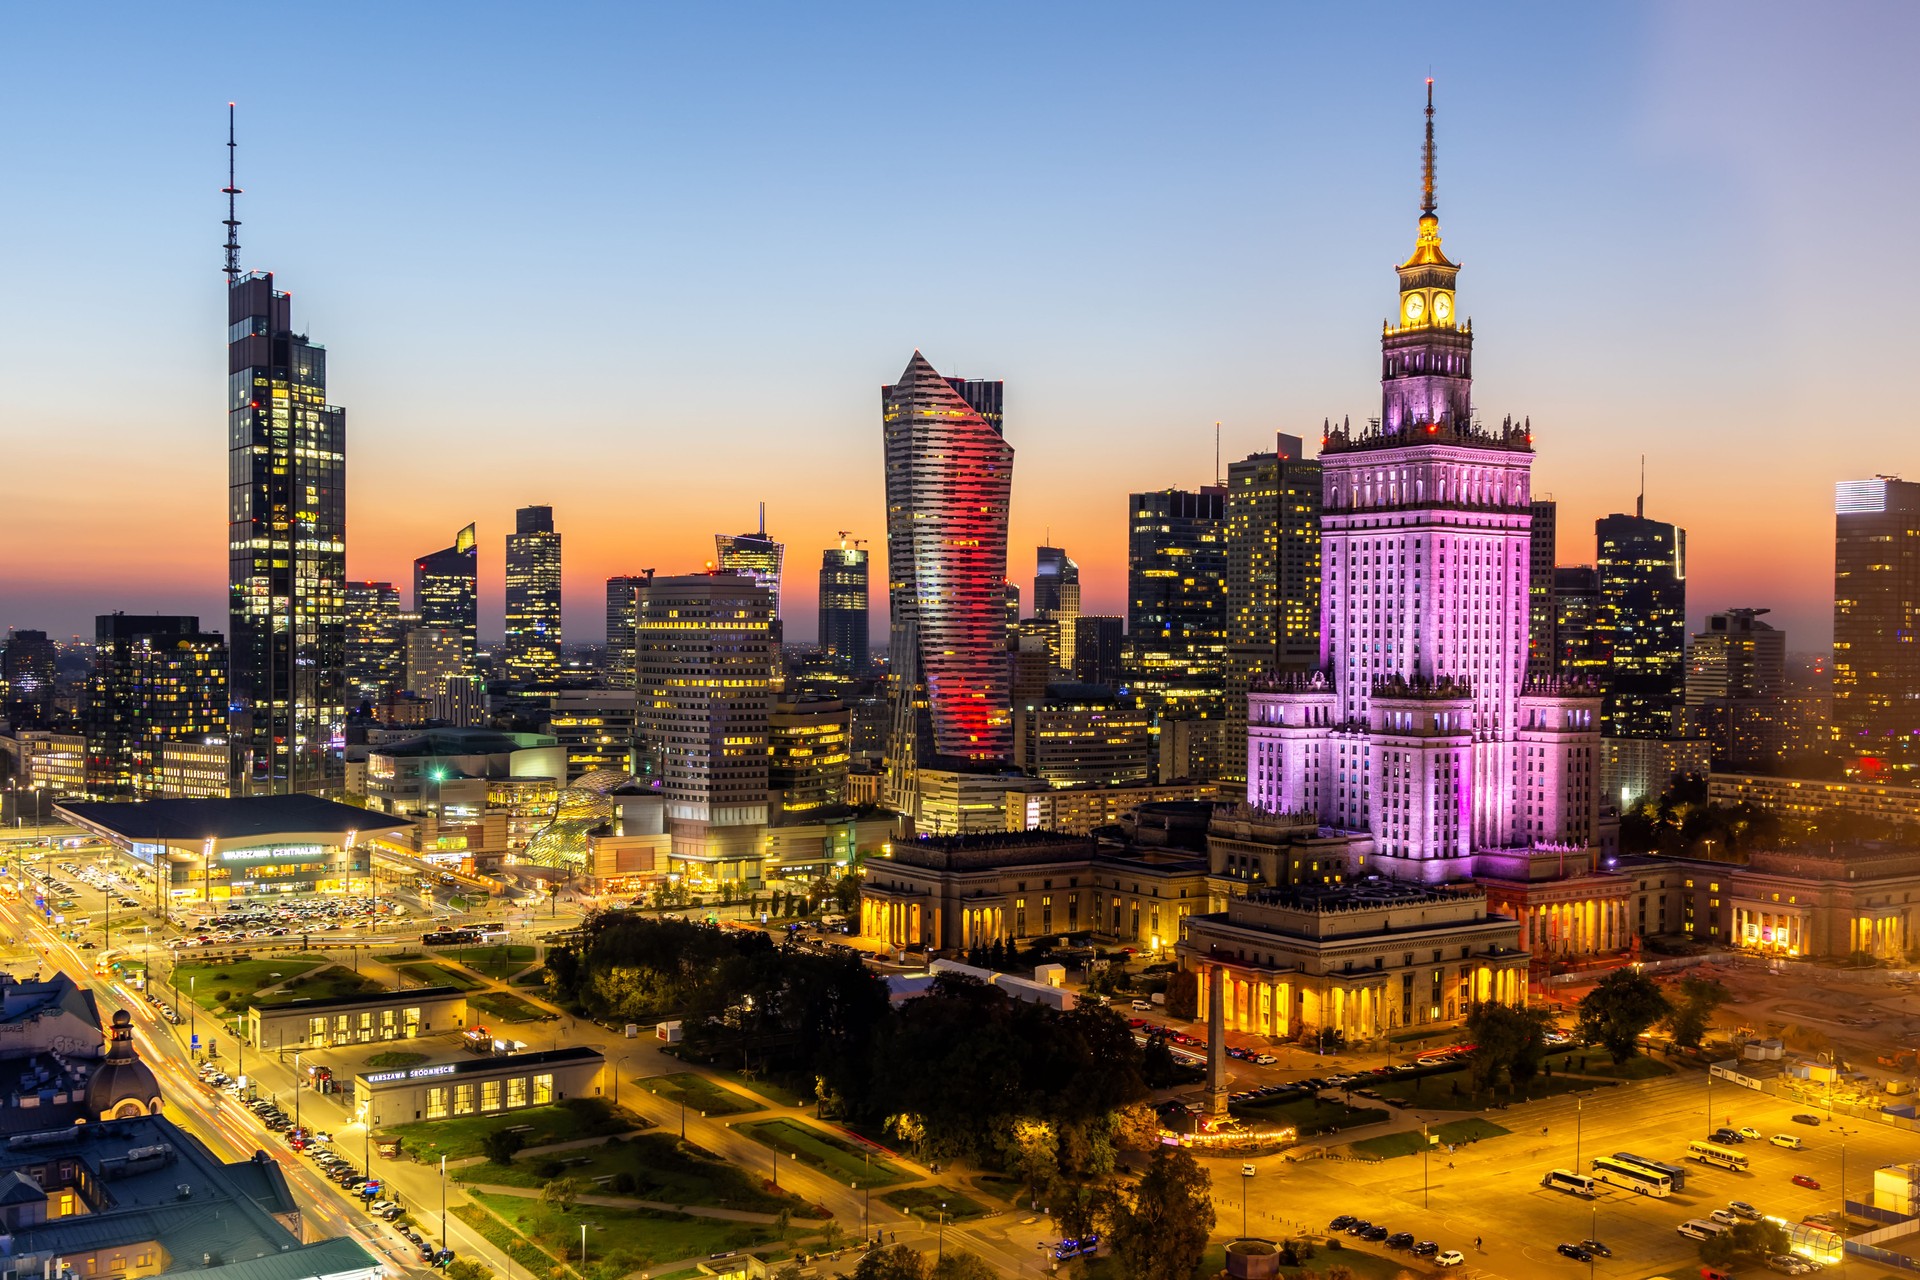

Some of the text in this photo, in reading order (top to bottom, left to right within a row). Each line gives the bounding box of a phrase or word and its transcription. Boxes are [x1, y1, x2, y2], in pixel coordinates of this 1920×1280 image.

[222, 847, 321, 859] WARSZAWA CENTRALNA
[368, 1066, 455, 1082] WARSZAWA ŚRÓDMIEŚCIE
